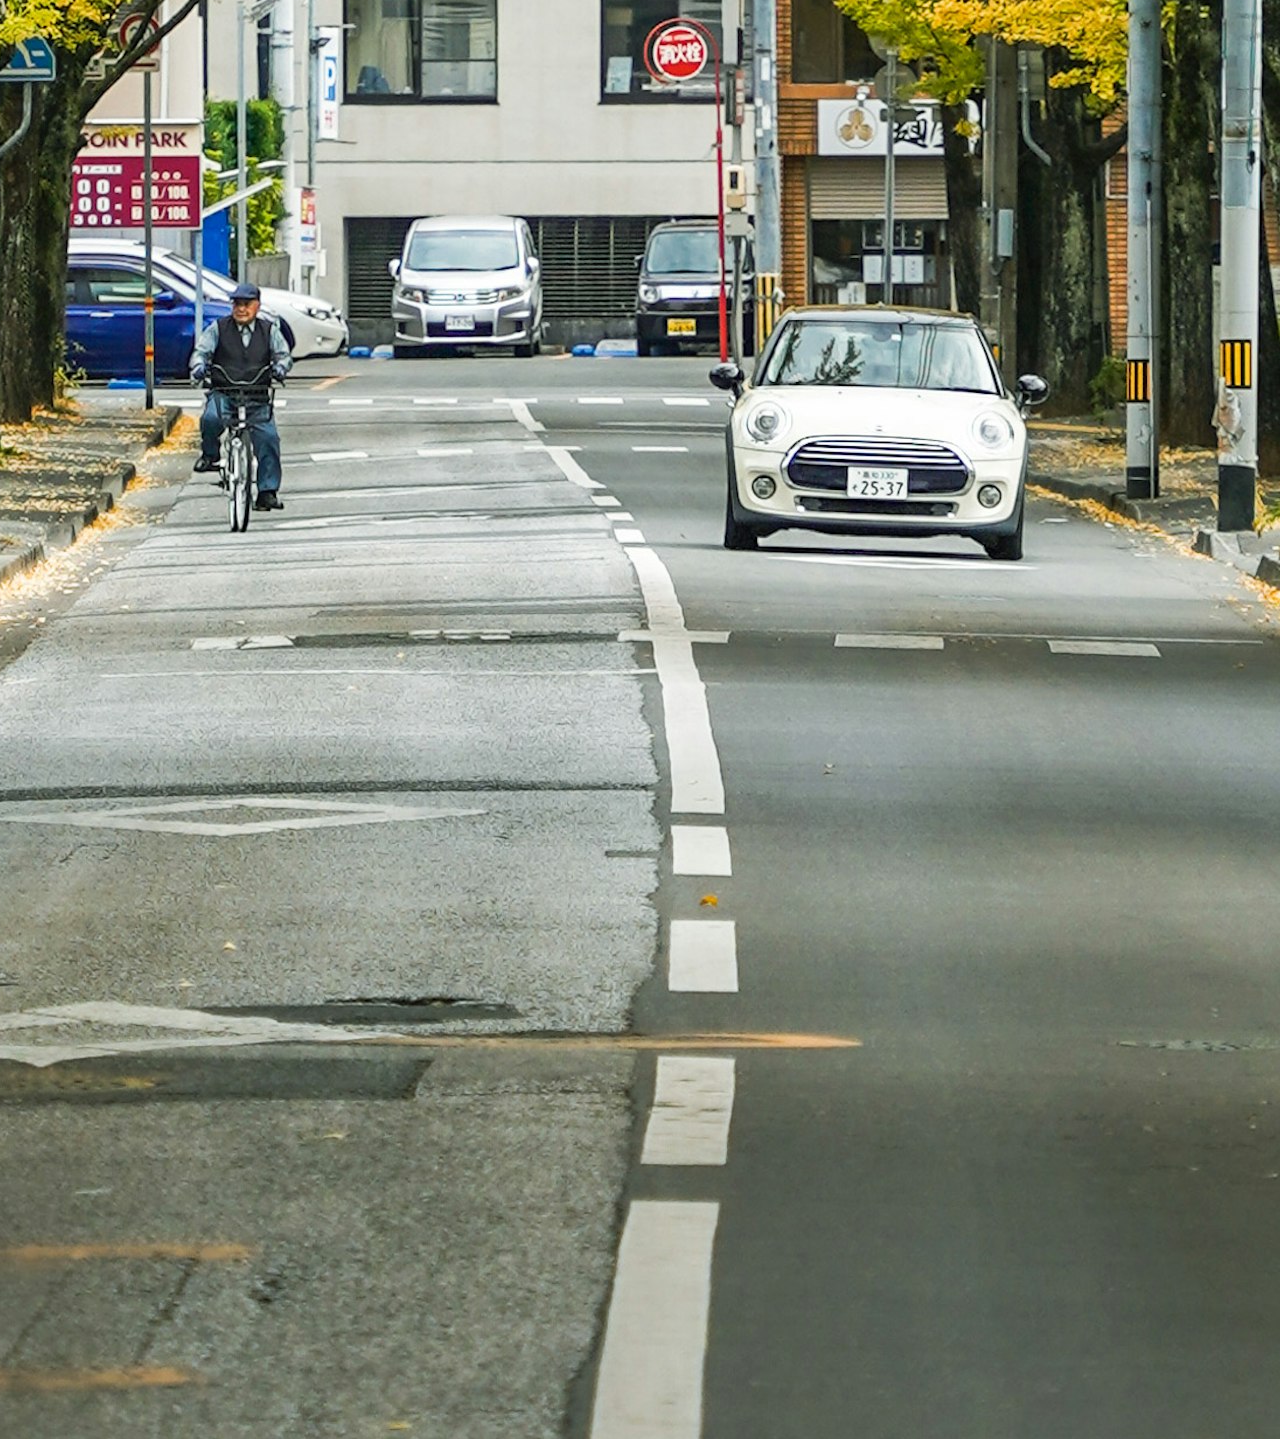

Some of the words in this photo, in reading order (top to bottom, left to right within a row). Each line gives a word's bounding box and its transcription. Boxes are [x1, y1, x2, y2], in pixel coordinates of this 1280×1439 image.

[659, 42, 702, 65] 消火栓
[861, 481, 904, 496] 25-37
